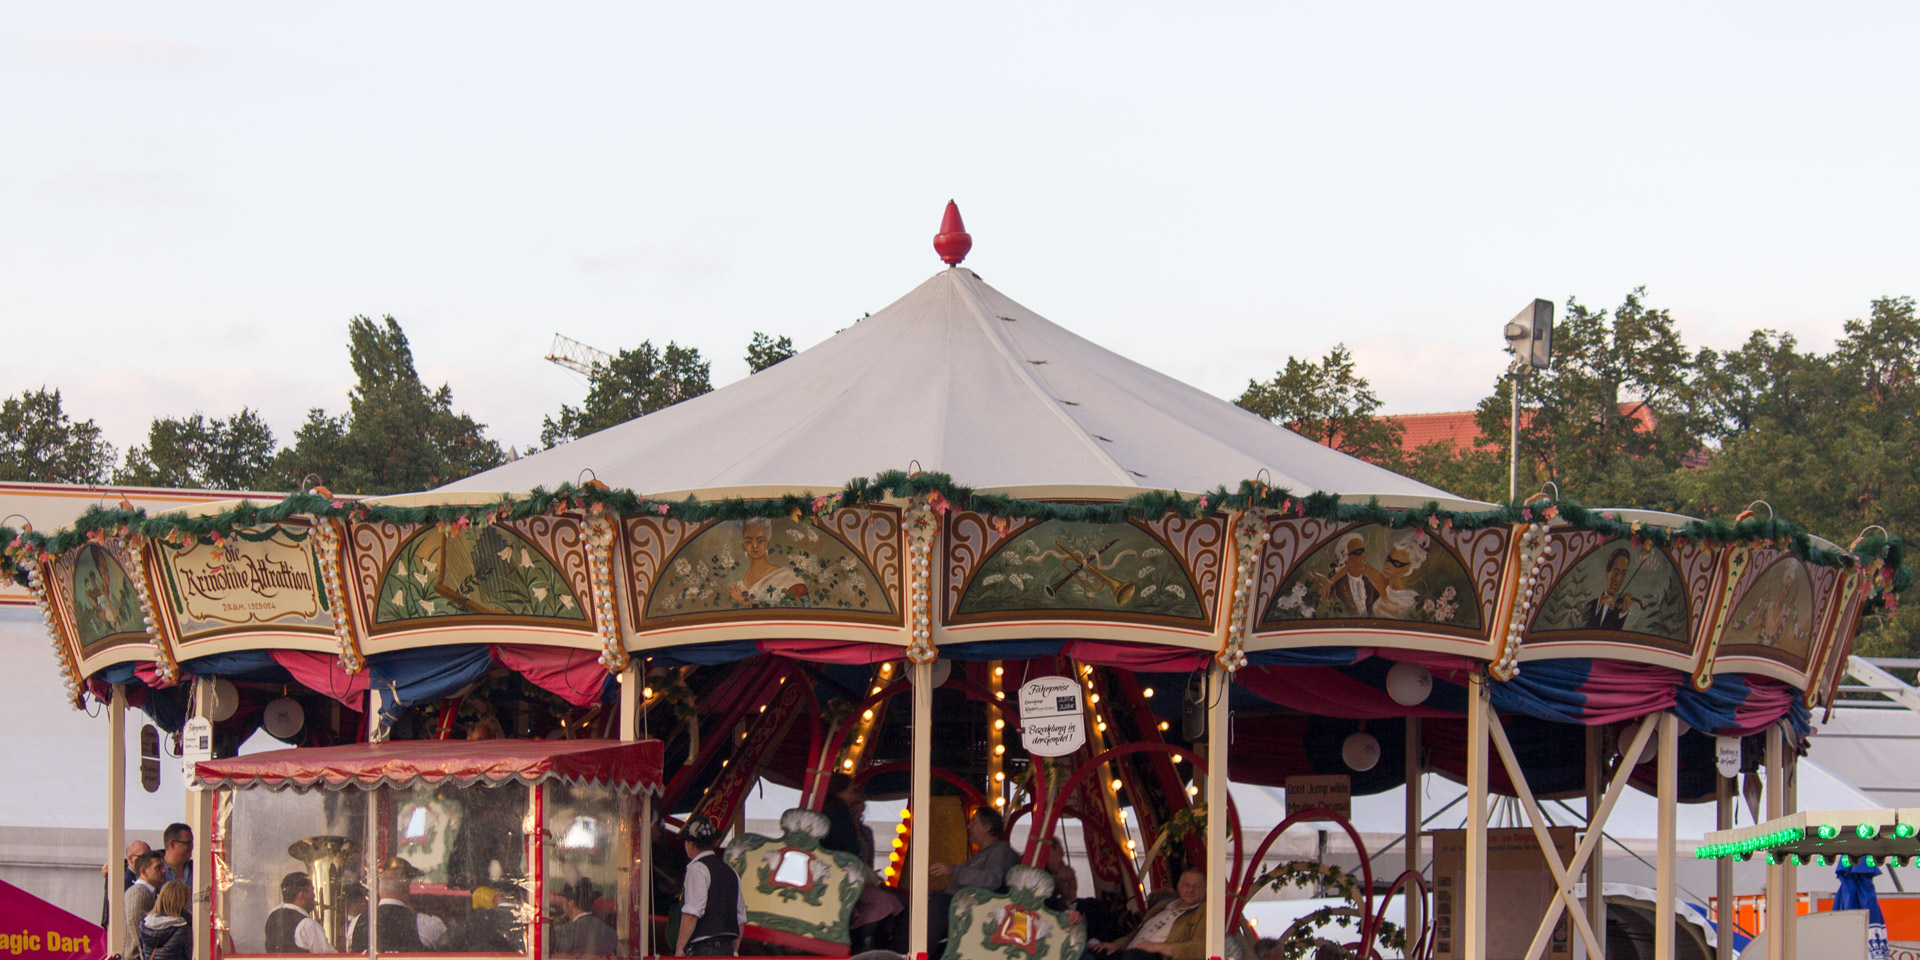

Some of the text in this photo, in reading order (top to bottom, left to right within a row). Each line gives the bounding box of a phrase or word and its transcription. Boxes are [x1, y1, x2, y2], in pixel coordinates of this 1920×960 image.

[224, 546, 240, 563] die
[1028, 683, 1070, 698] Fahrpreise
[1028, 723, 1076, 738] Bezahlung in
[1307, 783, 1328, 797] Jump
[46, 931, 91, 953] Dart
